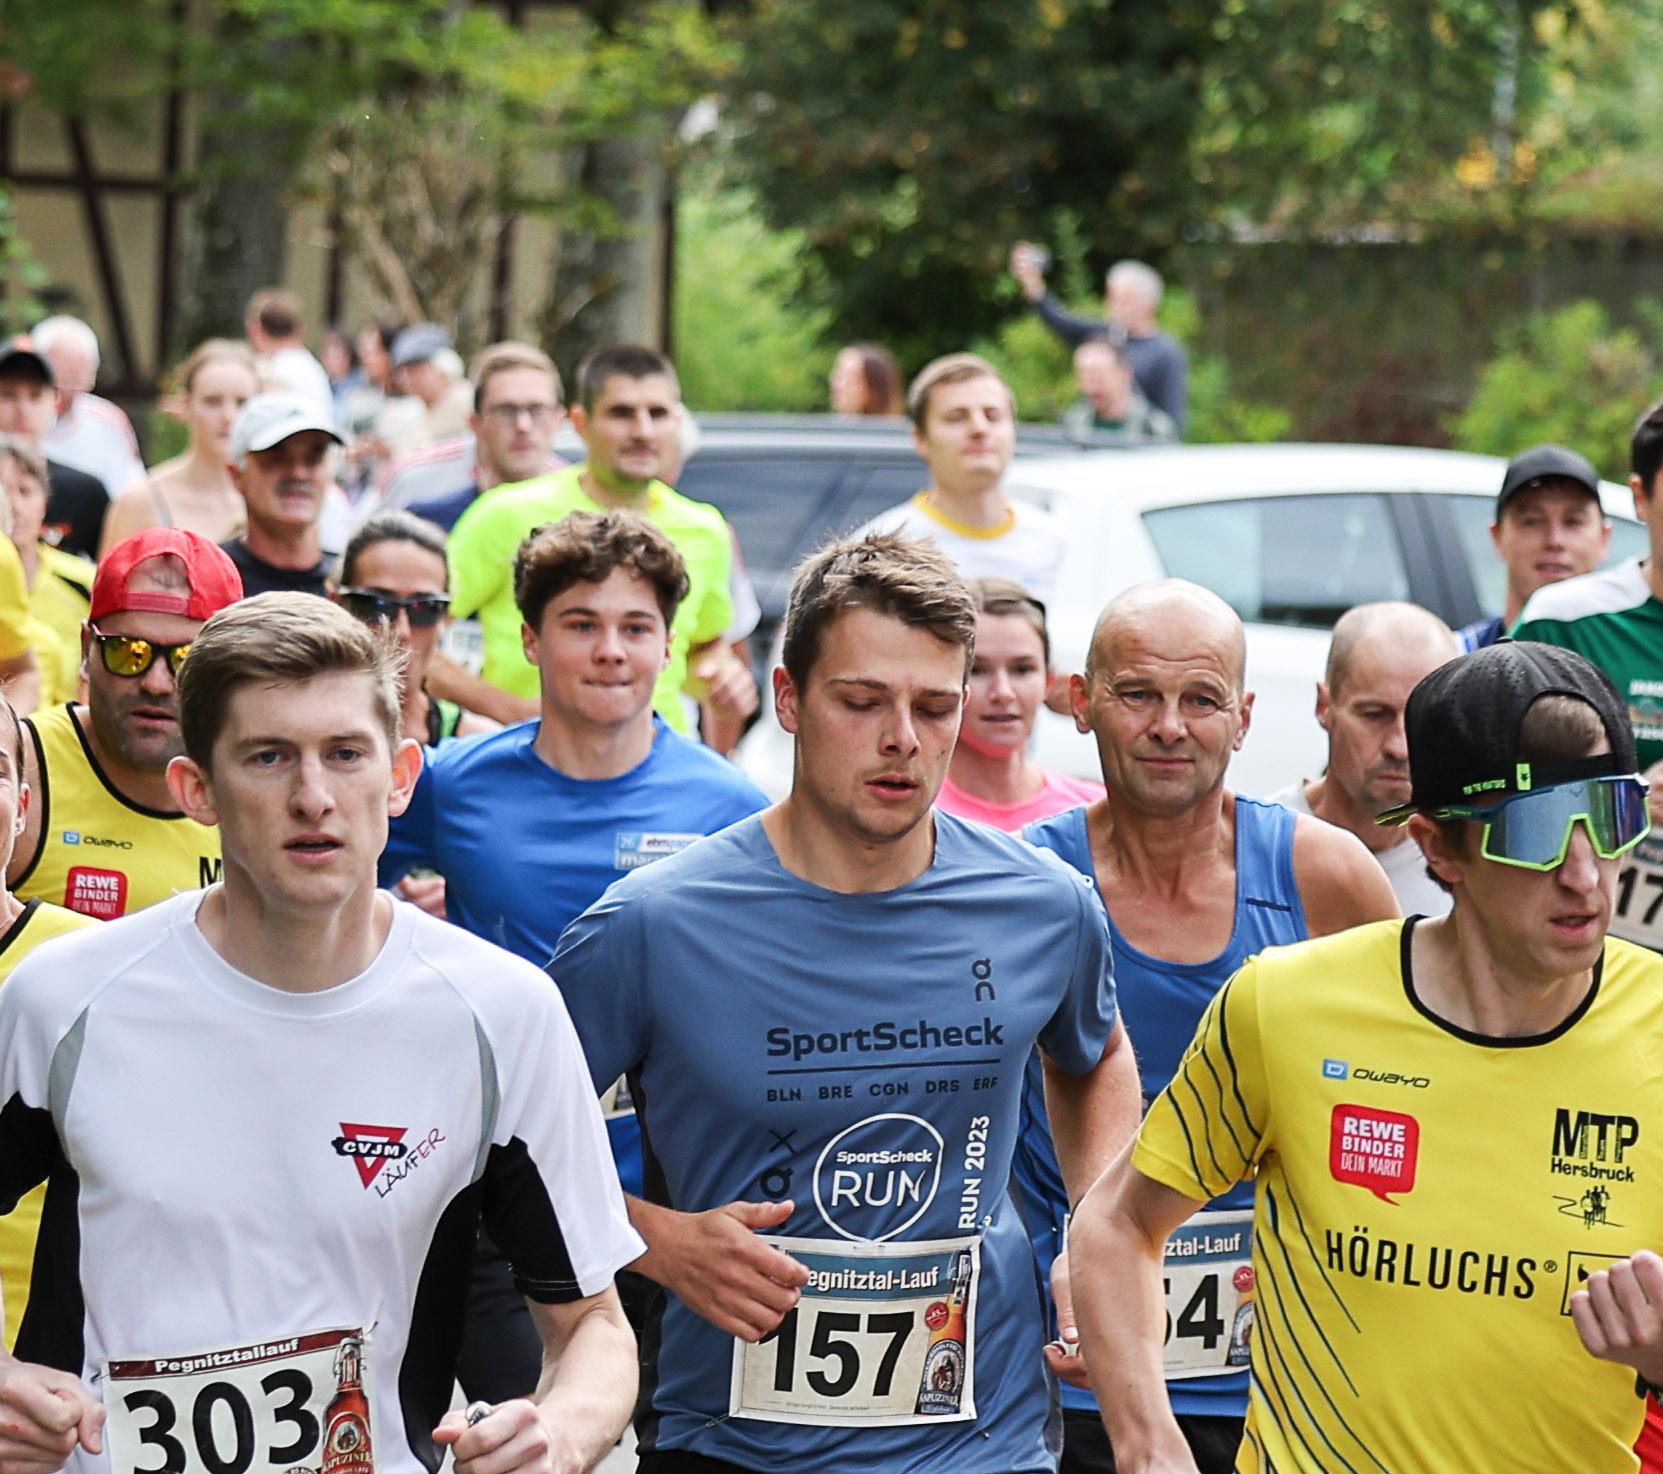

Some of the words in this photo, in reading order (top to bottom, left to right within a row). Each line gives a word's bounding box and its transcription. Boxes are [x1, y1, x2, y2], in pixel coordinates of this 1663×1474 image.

[74, 888, 119, 901] BINDER
[75, 873, 119, 890] REWE
[766, 1017, 1005, 1062] SportScheck
[767, 1088, 802, 1103] BLN
[818, 1085, 853, 1100] BRE
[869, 1081, 909, 1097] CGN
[925, 1079, 960, 1094] DRS
[973, 1076, 1000, 1091] ERF
[1343, 1116, 1407, 1143] REWE
[1552, 1107, 1639, 1164] MTP
[342, 1140, 400, 1157] CVJM
[836, 1149, 933, 1165] SportScheck
[965, 1116, 991, 1172] 2023
[1341, 1135, 1405, 1160] BINDER
[375, 1128, 446, 1198] LÄUFER
[1340, 1152, 1365, 1174] DEIN
[1367, 1157, 1403, 1179] MARKT
[1550, 1156, 1635, 1183] Hersbruck
[831, 1169, 927, 1208] RUN
[958, 1178, 982, 1229] RUN
[1163, 1233, 1242, 1257] ztal-Lauf
[808, 1265, 940, 1292] egnitztal-Lauf
[155, 1338, 300, 1374] Pegnitztallauf
[758, 1307, 915, 1398] 157
